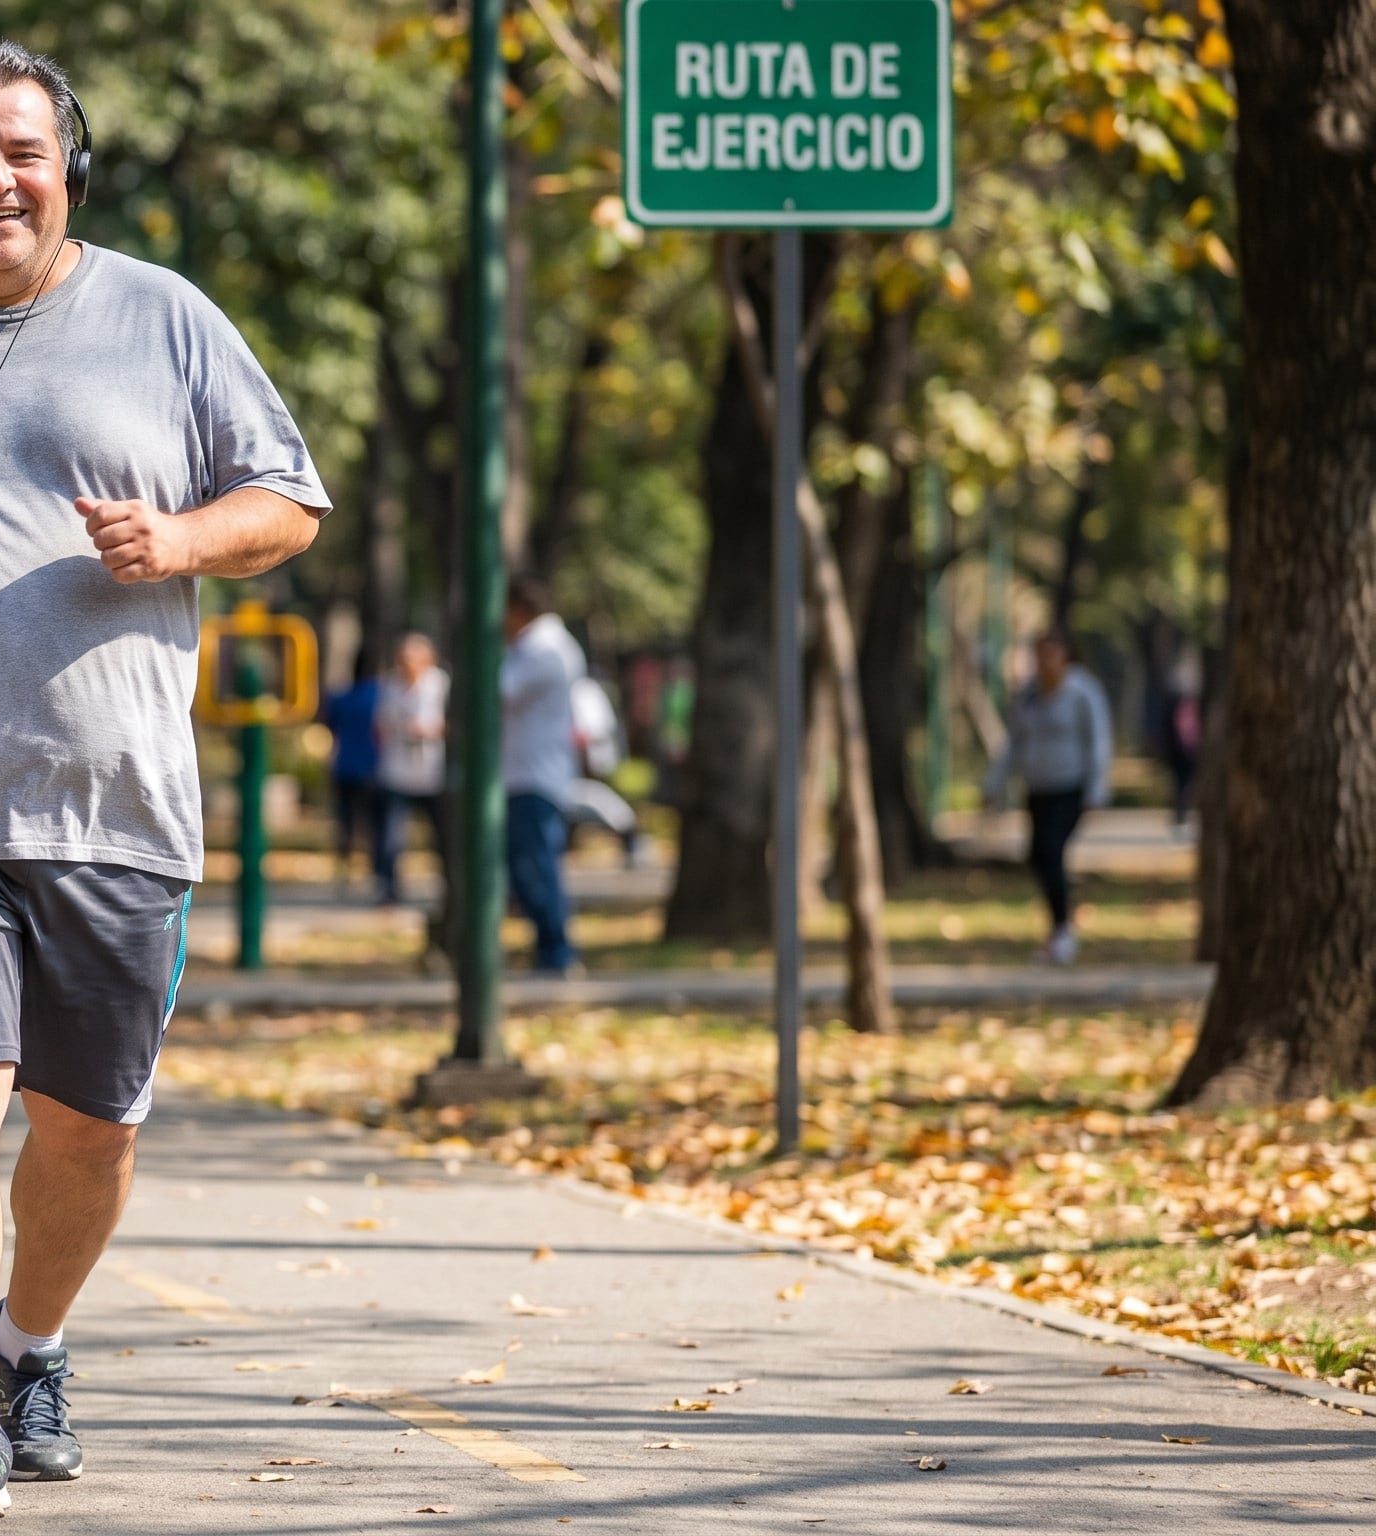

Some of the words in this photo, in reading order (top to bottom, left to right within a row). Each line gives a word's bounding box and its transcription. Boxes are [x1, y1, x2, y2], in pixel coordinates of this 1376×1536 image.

[675, 41, 816, 99] RUTA
[830, 42, 901, 99] DE
[652, 113, 924, 172] EJERCICIO
